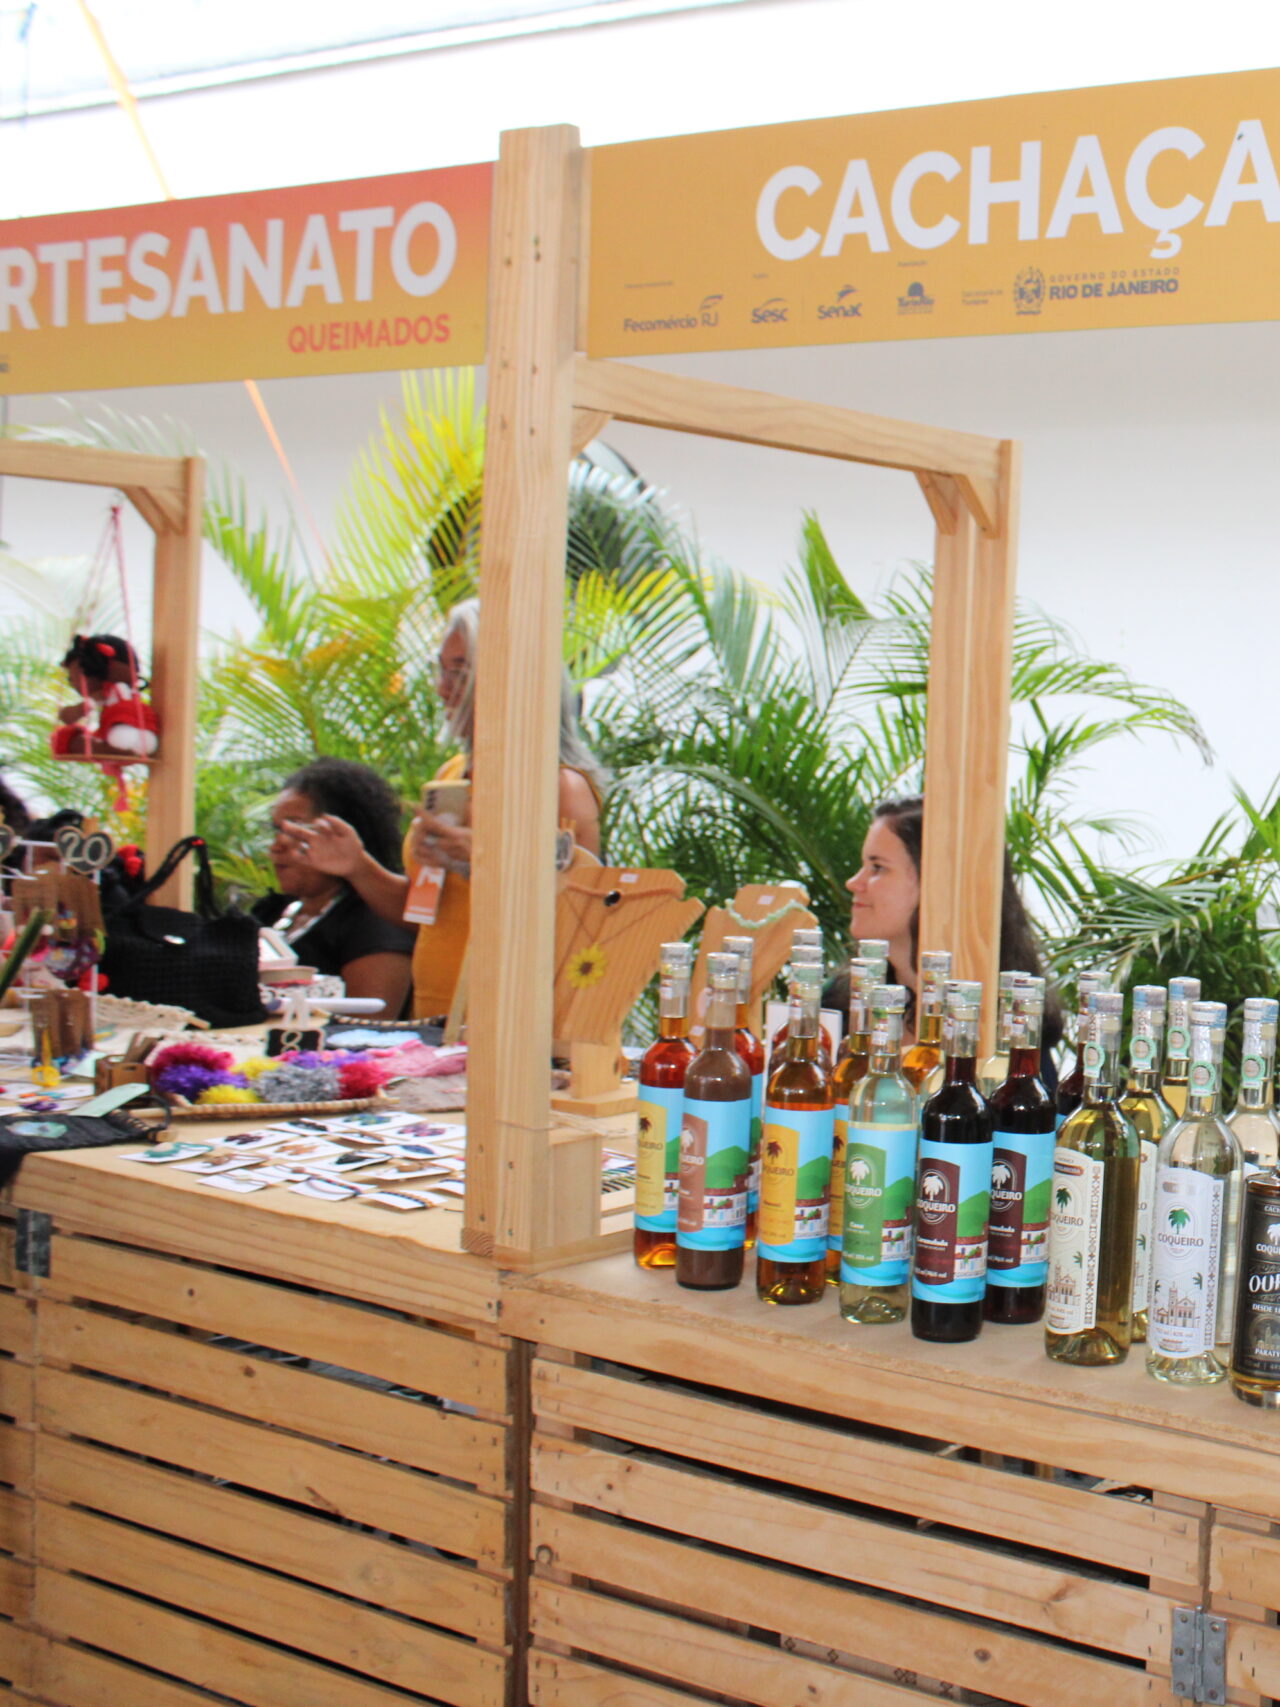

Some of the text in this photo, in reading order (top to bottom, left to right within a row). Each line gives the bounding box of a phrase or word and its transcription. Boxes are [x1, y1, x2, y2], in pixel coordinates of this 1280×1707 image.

[1049, 278, 1179, 300] RIO DE JANEIRO
[623, 315, 697, 333] Fecomércio
[287, 313, 452, 354] QUEIMADOS
[61, 831, 108, 868] 20
[1157, 1232, 1205, 1248] COQUEIRO
[1252, 1303, 1273, 1313] DESDE
[1254, 1348, 1280, 1358] PARATY
